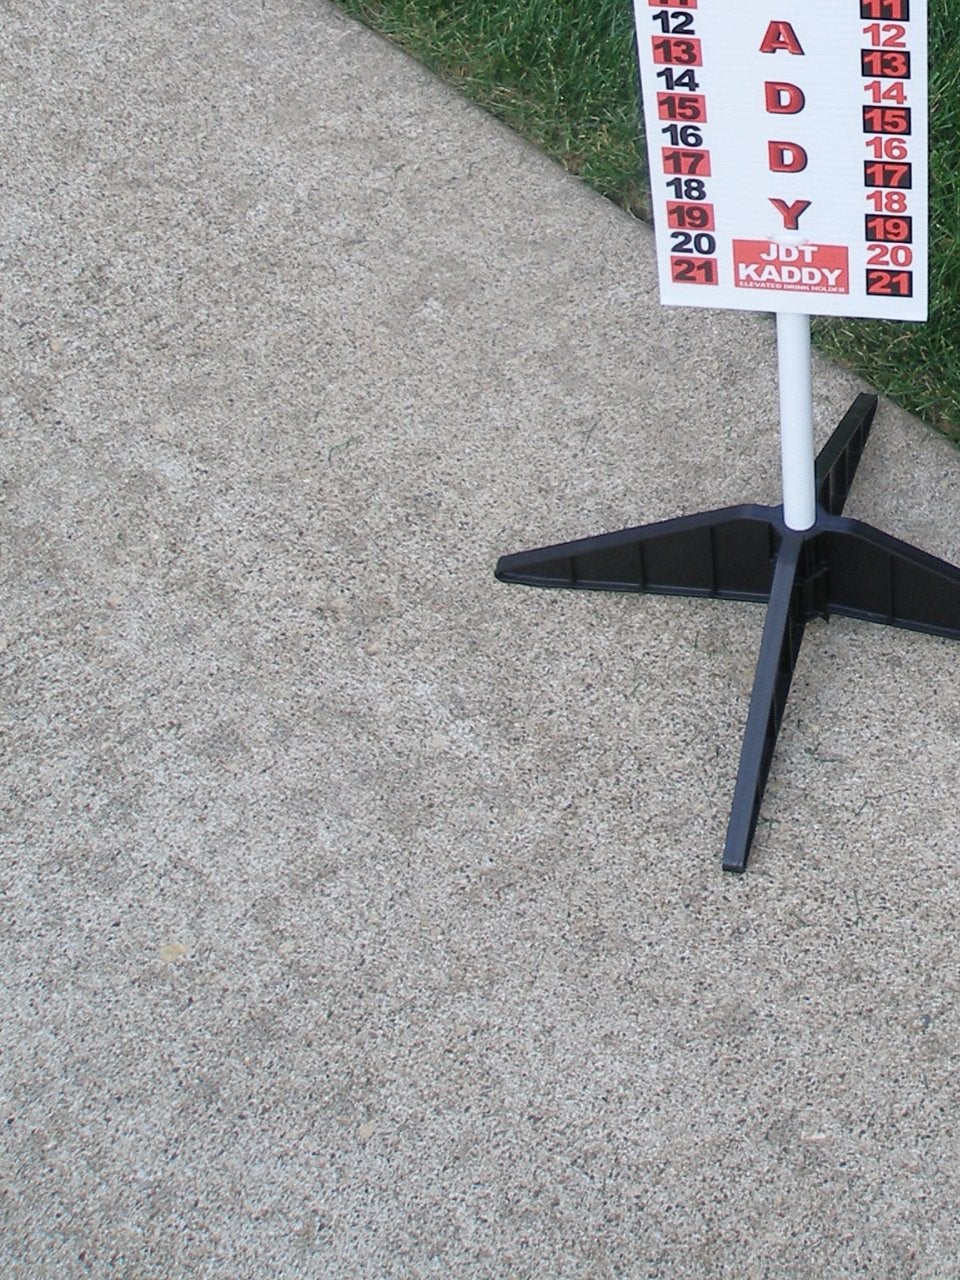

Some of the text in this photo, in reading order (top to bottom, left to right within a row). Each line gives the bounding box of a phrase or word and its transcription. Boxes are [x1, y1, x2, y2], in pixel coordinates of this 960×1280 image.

[651, 10, 695, 35] 12
[862, 23, 906, 48] 12
[653, 39, 698, 64] 13
[863, 51, 906, 76] 13
[656, 67, 699, 91] 14
[863, 81, 908, 105] 14
[658, 95, 700, 120] 15
[864, 108, 907, 133] 15
[661, 123, 704, 148] 16
[865, 136, 908, 160] 16
[664, 151, 705, 174] 17
[865, 163, 909, 187] 17
[666, 177, 707, 200] 18
[866, 191, 907, 213] 18
[668, 204, 709, 228] 19
[867, 217, 908, 241] 19
[670, 231, 716, 255] 20
[760, 244, 818, 263] JDT
[866, 244, 913, 267] 20
[672, 259, 713, 282] 21
[738, 263, 842, 286] KADDY
[868, 271, 910, 295] 21
